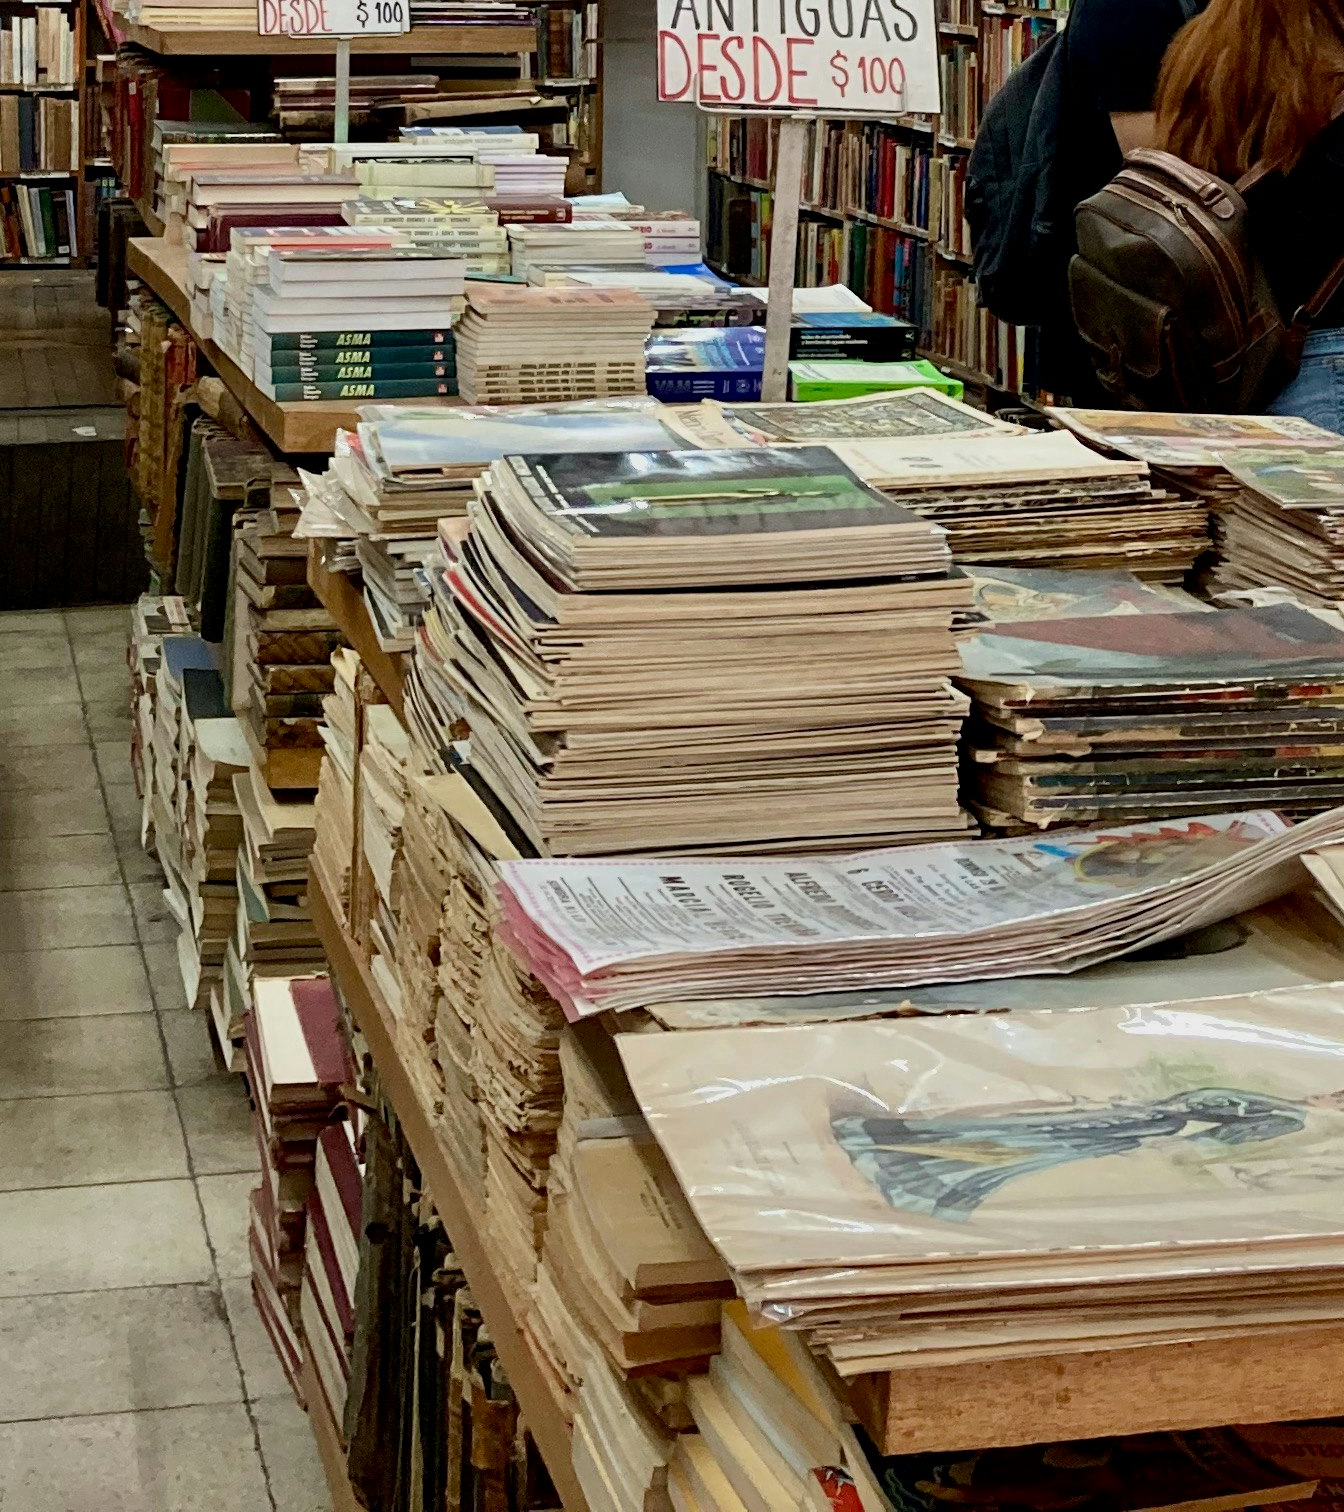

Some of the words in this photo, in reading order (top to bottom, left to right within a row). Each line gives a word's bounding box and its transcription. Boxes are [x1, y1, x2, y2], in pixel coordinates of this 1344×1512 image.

[659, 30, 818, 106] DESDE
[336, 334, 372, 346] ASMA
[335, 351, 371, 364] ASMA
[337, 367, 373, 379] ASMA
[340, 384, 375, 397] ASMA
[658, 875, 717, 918] MARCIAL
[721, 874, 776, 910] ROGELIO
